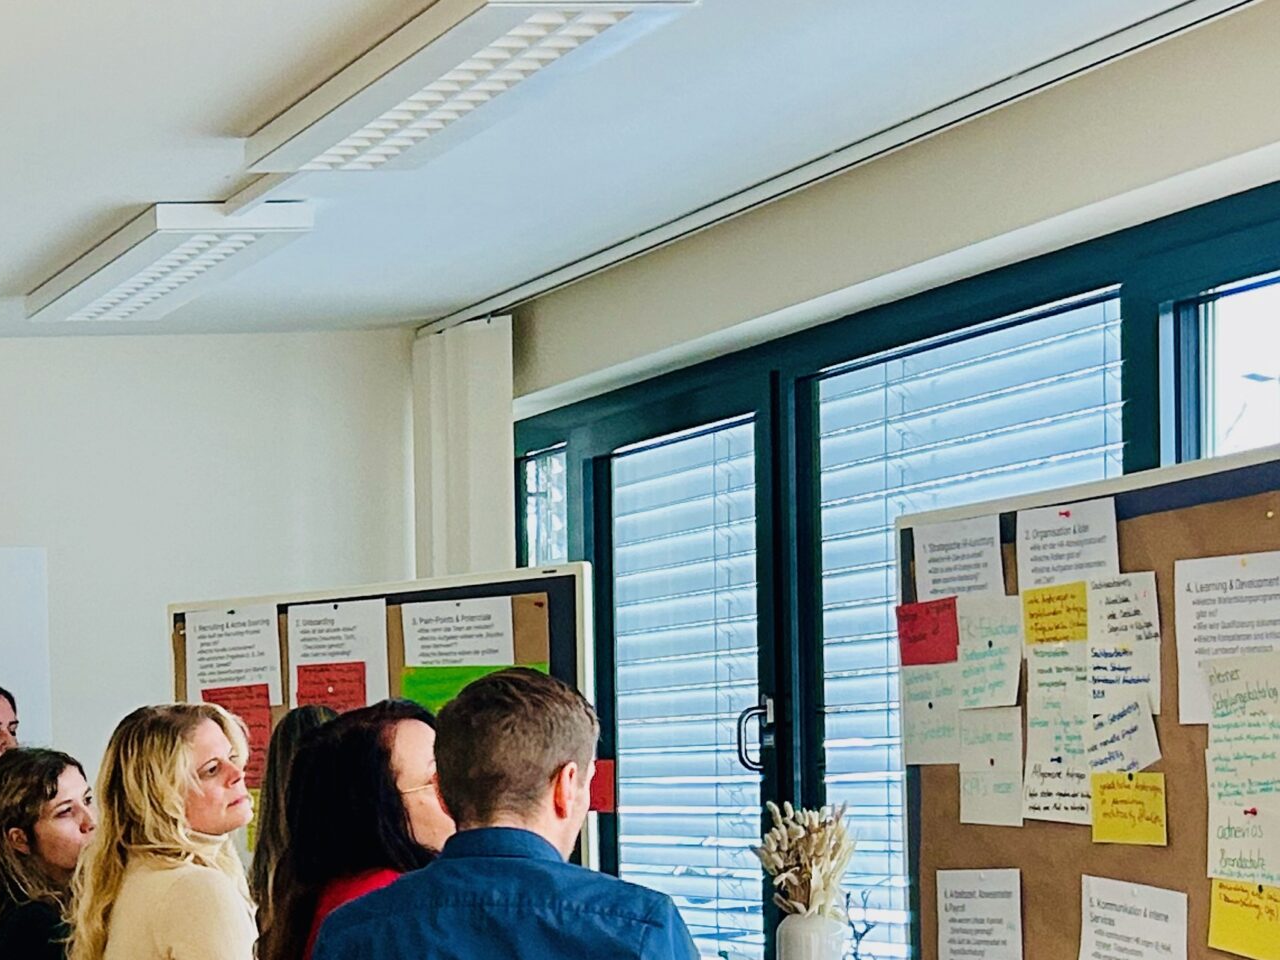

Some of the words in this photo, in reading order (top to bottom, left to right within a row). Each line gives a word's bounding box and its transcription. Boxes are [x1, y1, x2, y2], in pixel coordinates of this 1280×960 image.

[1194, 581, 1227, 593] Learning
[1228, 579, 1234, 590] &
[1235, 576, 1280, 590] Development
[1096, 898, 1142, 917] Kommunikation
